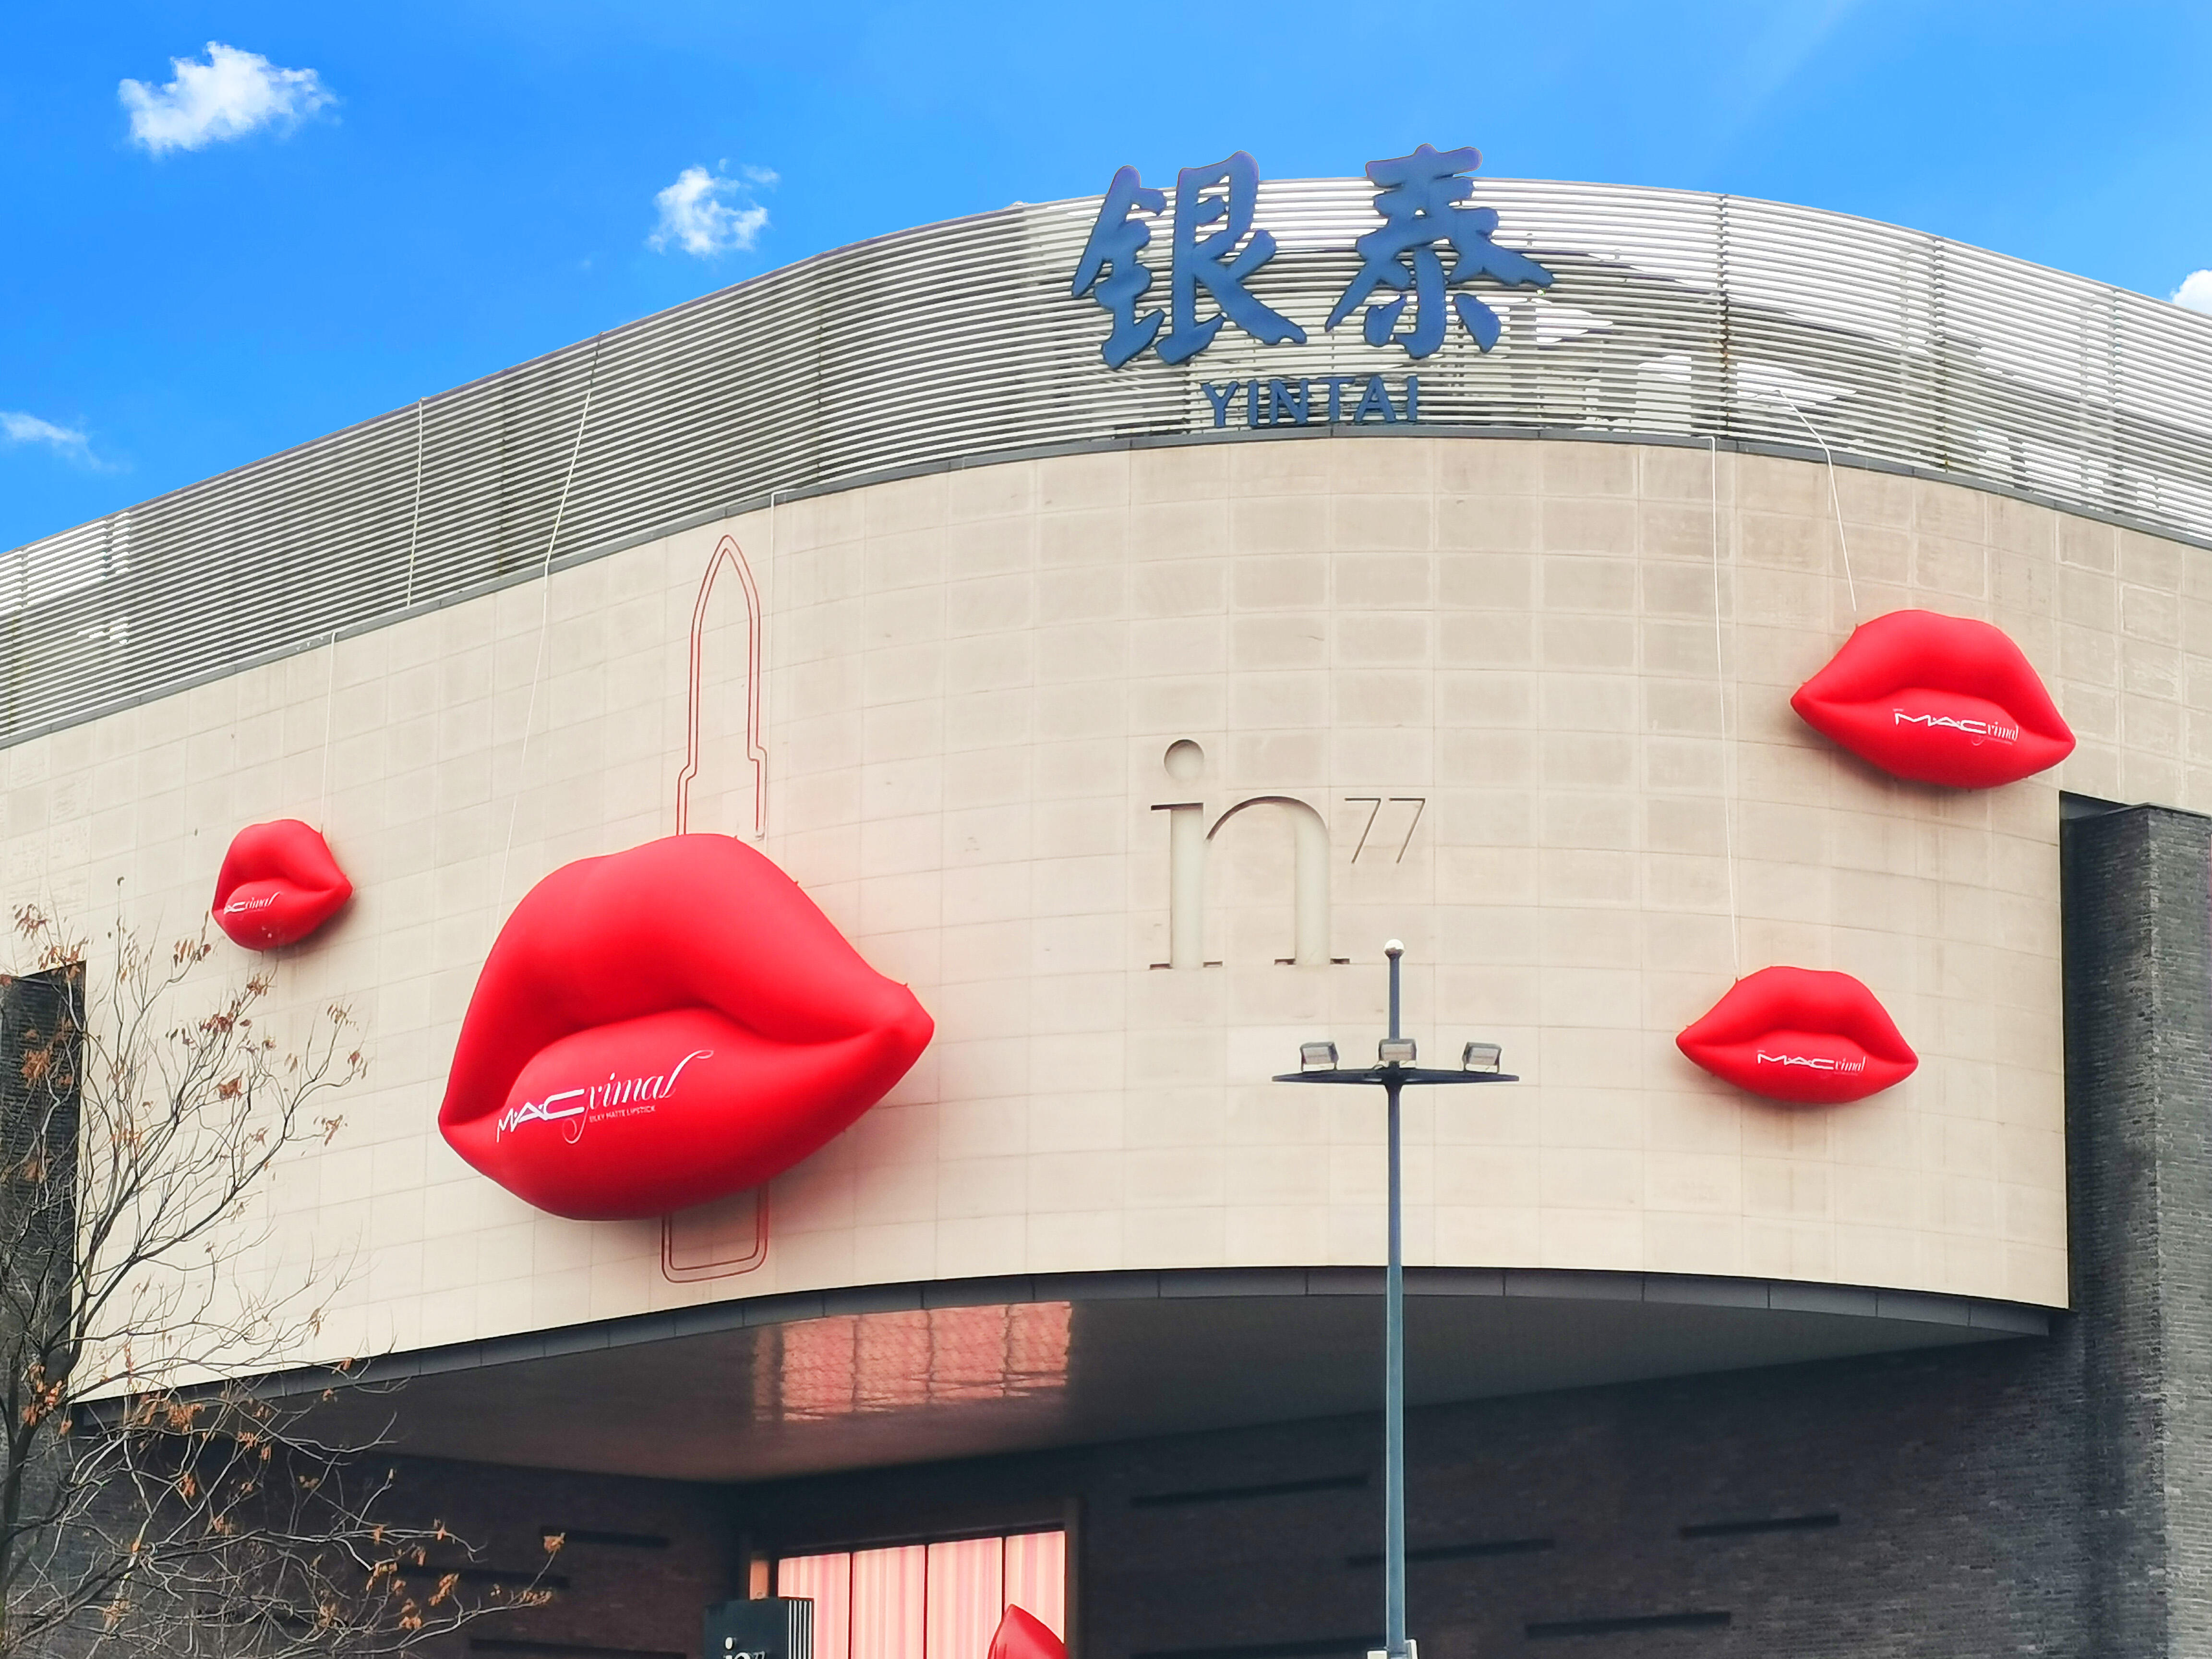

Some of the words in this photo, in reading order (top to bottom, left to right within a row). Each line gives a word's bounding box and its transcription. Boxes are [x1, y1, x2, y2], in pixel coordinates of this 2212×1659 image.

[1072, 143, 1555, 369] 银泰
[1202, 375, 1419, 428] YINTAI
[606, 1109, 625, 1119] MATTE
